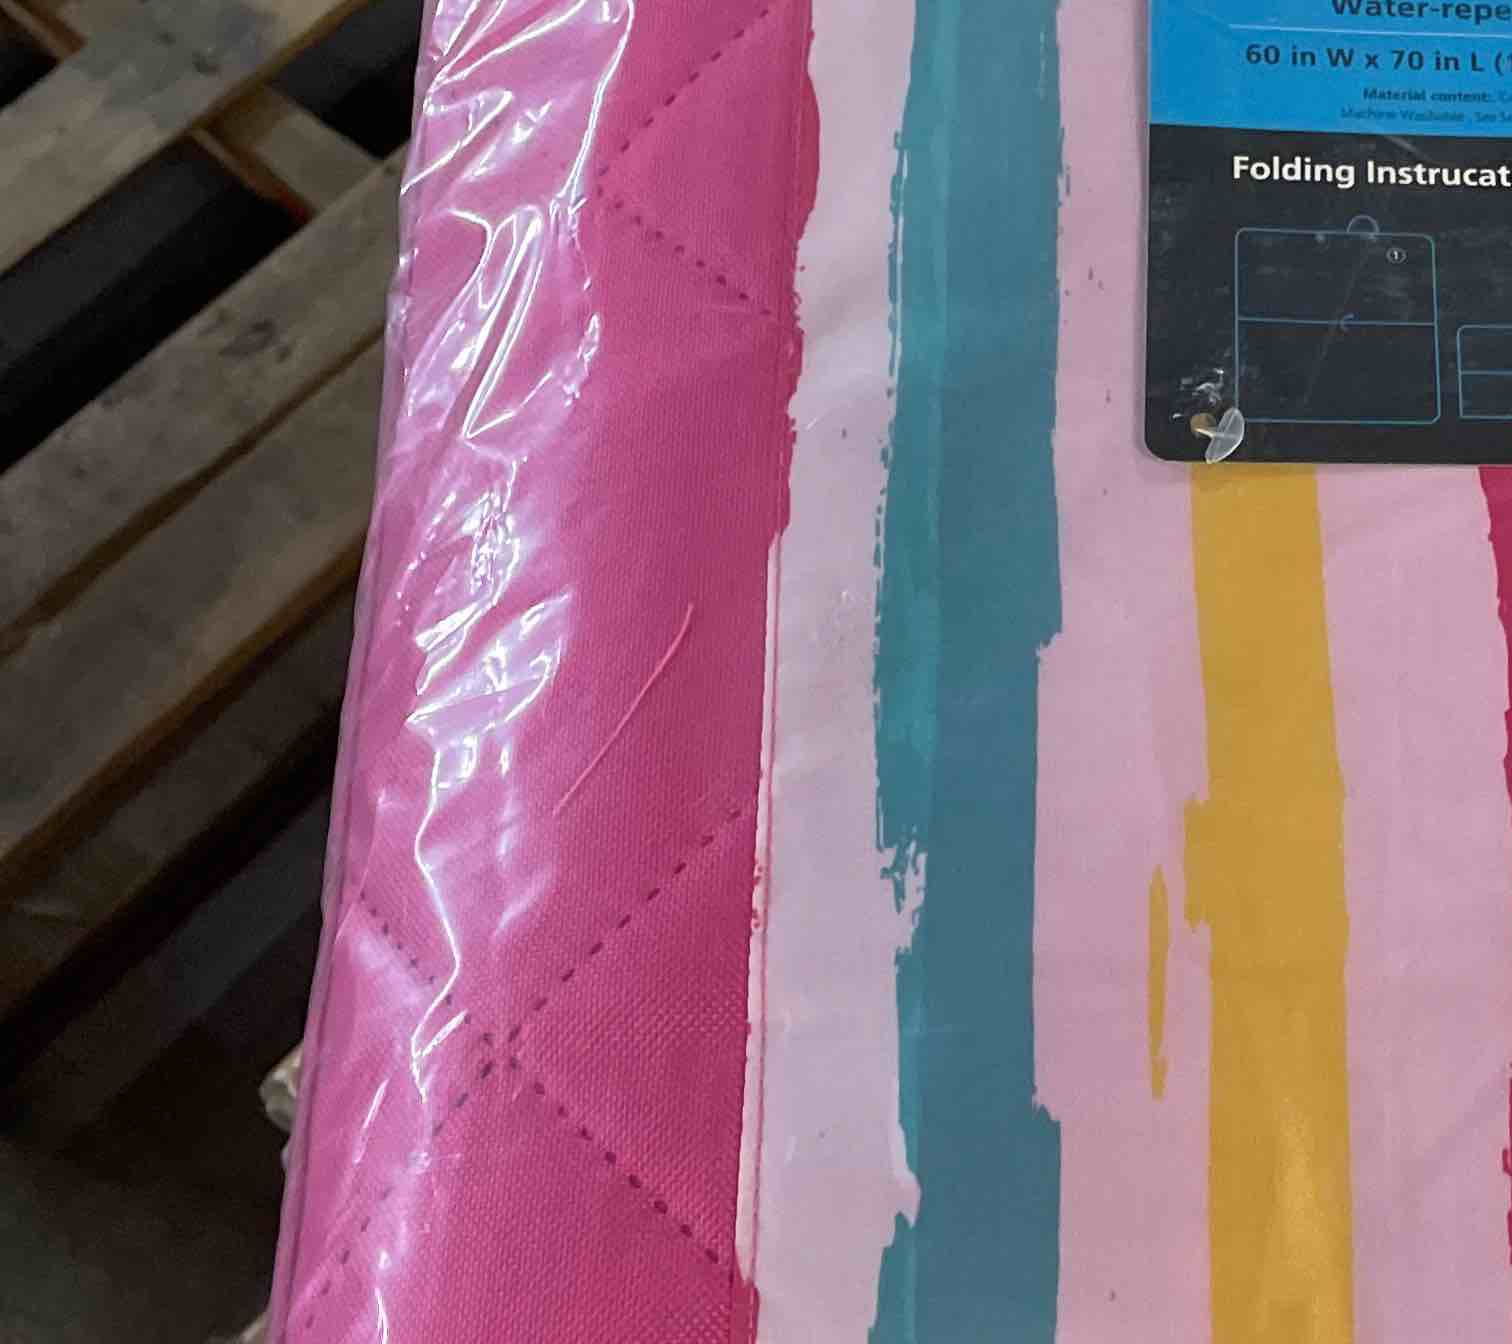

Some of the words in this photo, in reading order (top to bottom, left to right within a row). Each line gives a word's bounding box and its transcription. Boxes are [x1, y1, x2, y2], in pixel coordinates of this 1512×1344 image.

[1245, 44, 1281, 65] 60
[1291, 45, 1317, 66] in
[1327, 47, 1355, 68] W
[1365, 53, 1380, 69] x
[1391, 50, 1425, 71] 70
[1434, 50, 1460, 72] in
[1470, 52, 1485, 72] L
[1232, 155, 1355, 188] Folding
